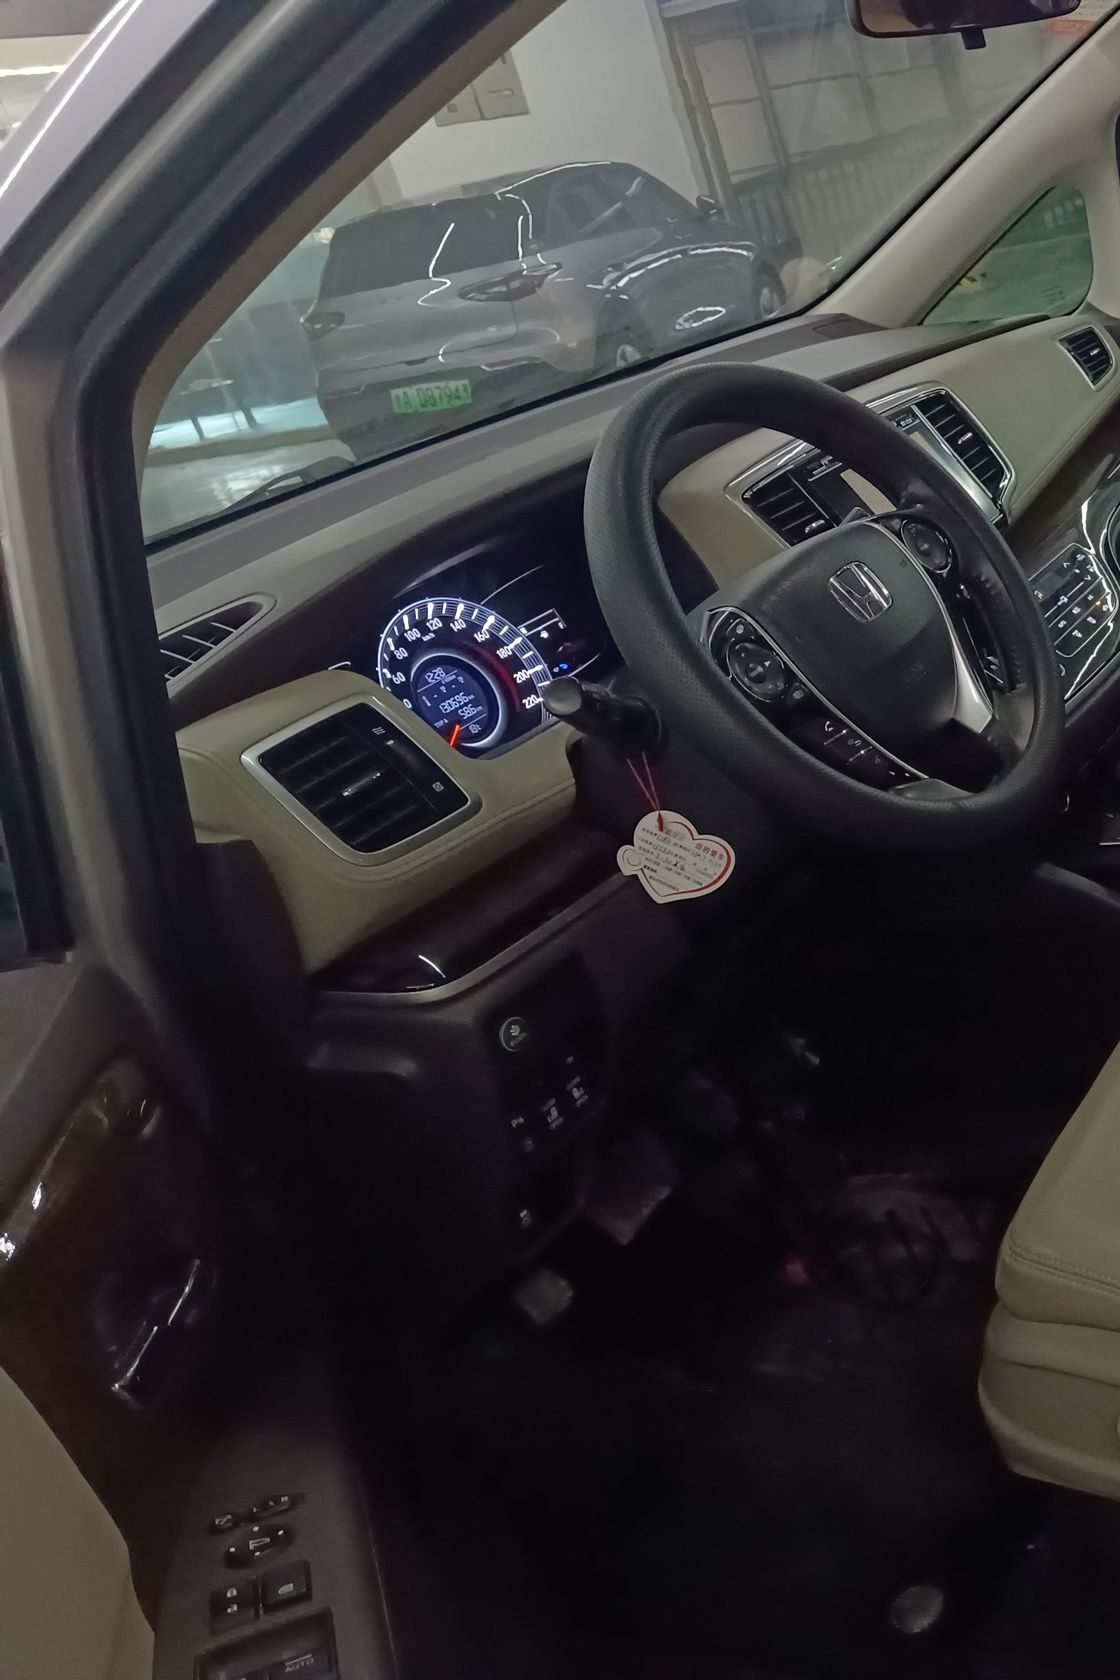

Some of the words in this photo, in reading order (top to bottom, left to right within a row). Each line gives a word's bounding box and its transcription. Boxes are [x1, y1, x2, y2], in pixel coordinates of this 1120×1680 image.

[426, 618, 443, 631] 120
[450, 619, 466, 632] 140
[404, 628, 421, 642] 100
[474, 630, 490, 643] 160
[394, 647, 408, 660] 80
[496, 646, 512, 659] 180
[392, 672, 405, 685] 60
[513, 669, 530, 684] 200
[522, 695, 539, 709] 220
